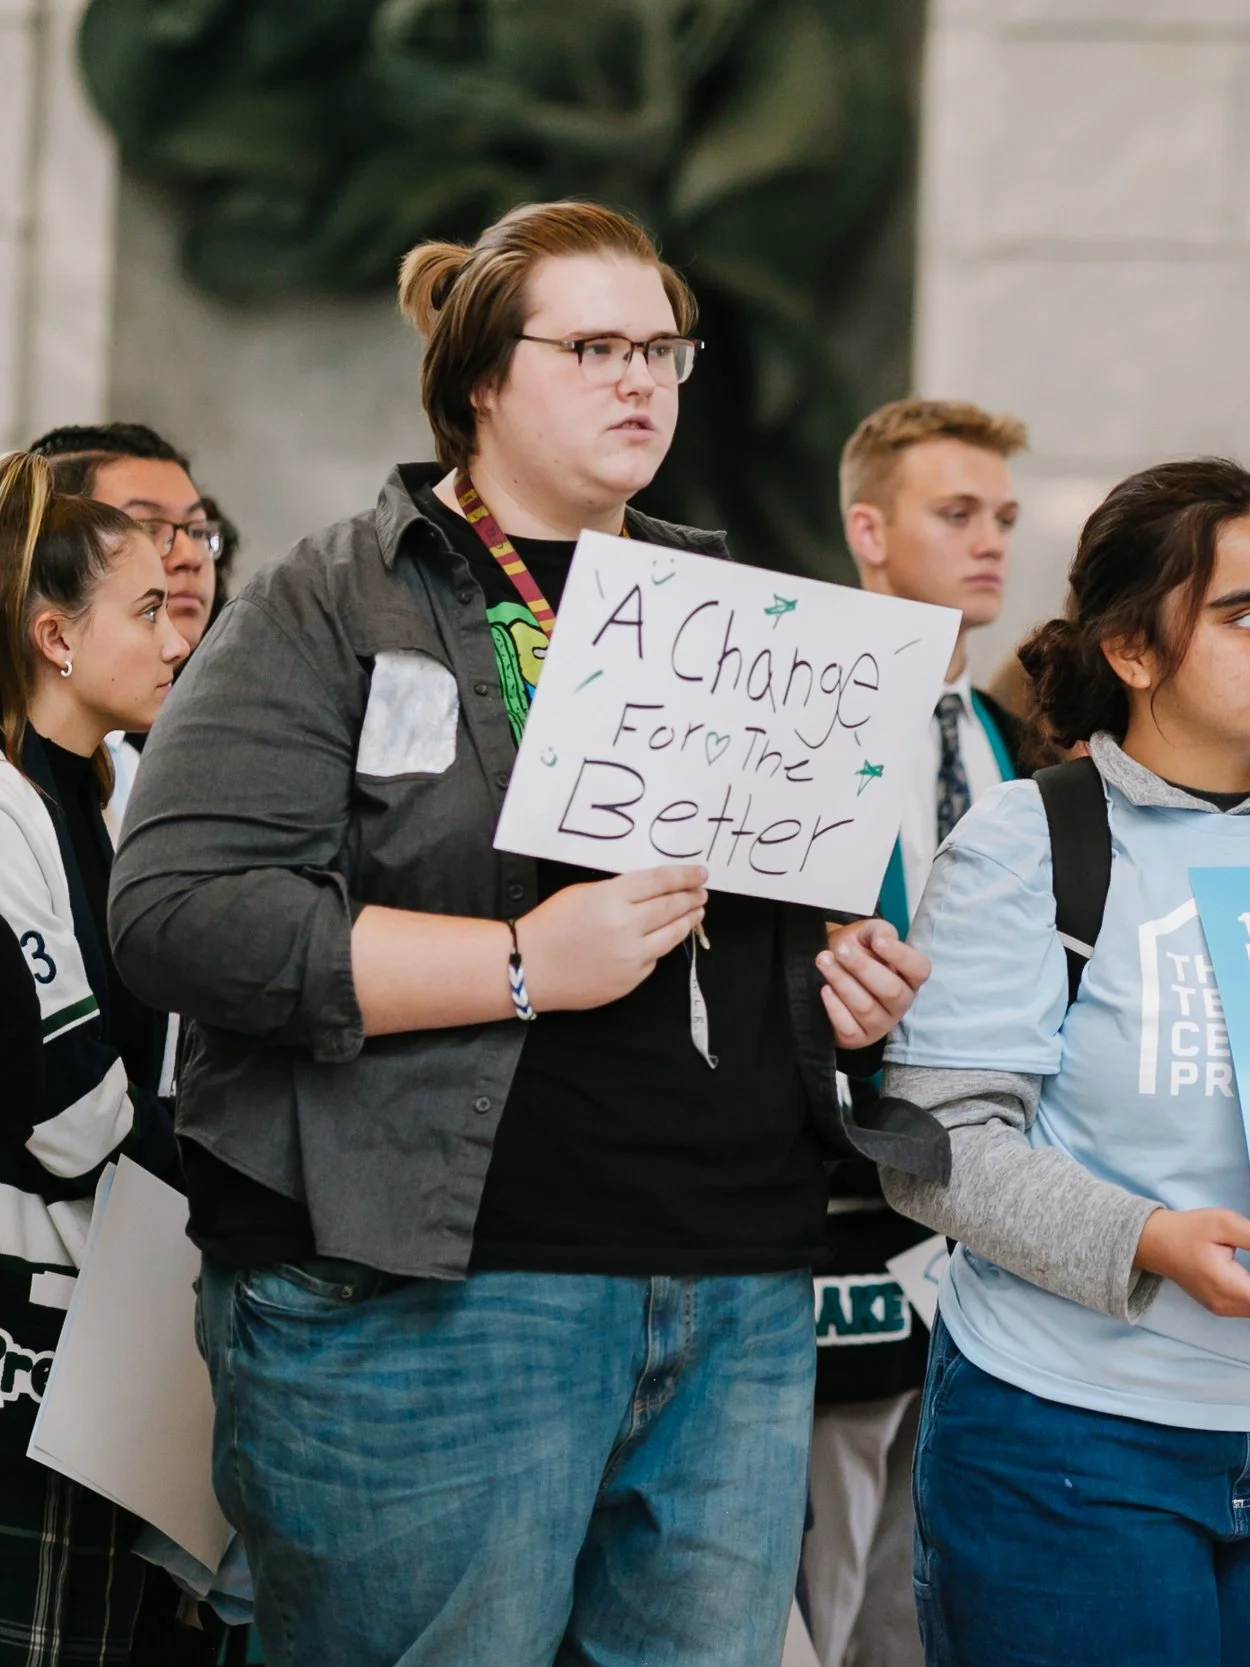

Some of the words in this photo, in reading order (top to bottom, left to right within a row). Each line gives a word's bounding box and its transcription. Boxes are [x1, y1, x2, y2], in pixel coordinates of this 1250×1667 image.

[592, 584, 644, 659] A
[672, 600, 881, 749] Change
[613, 703, 705, 751] For
[741, 727, 814, 782] The
[558, 757, 854, 875] Better
